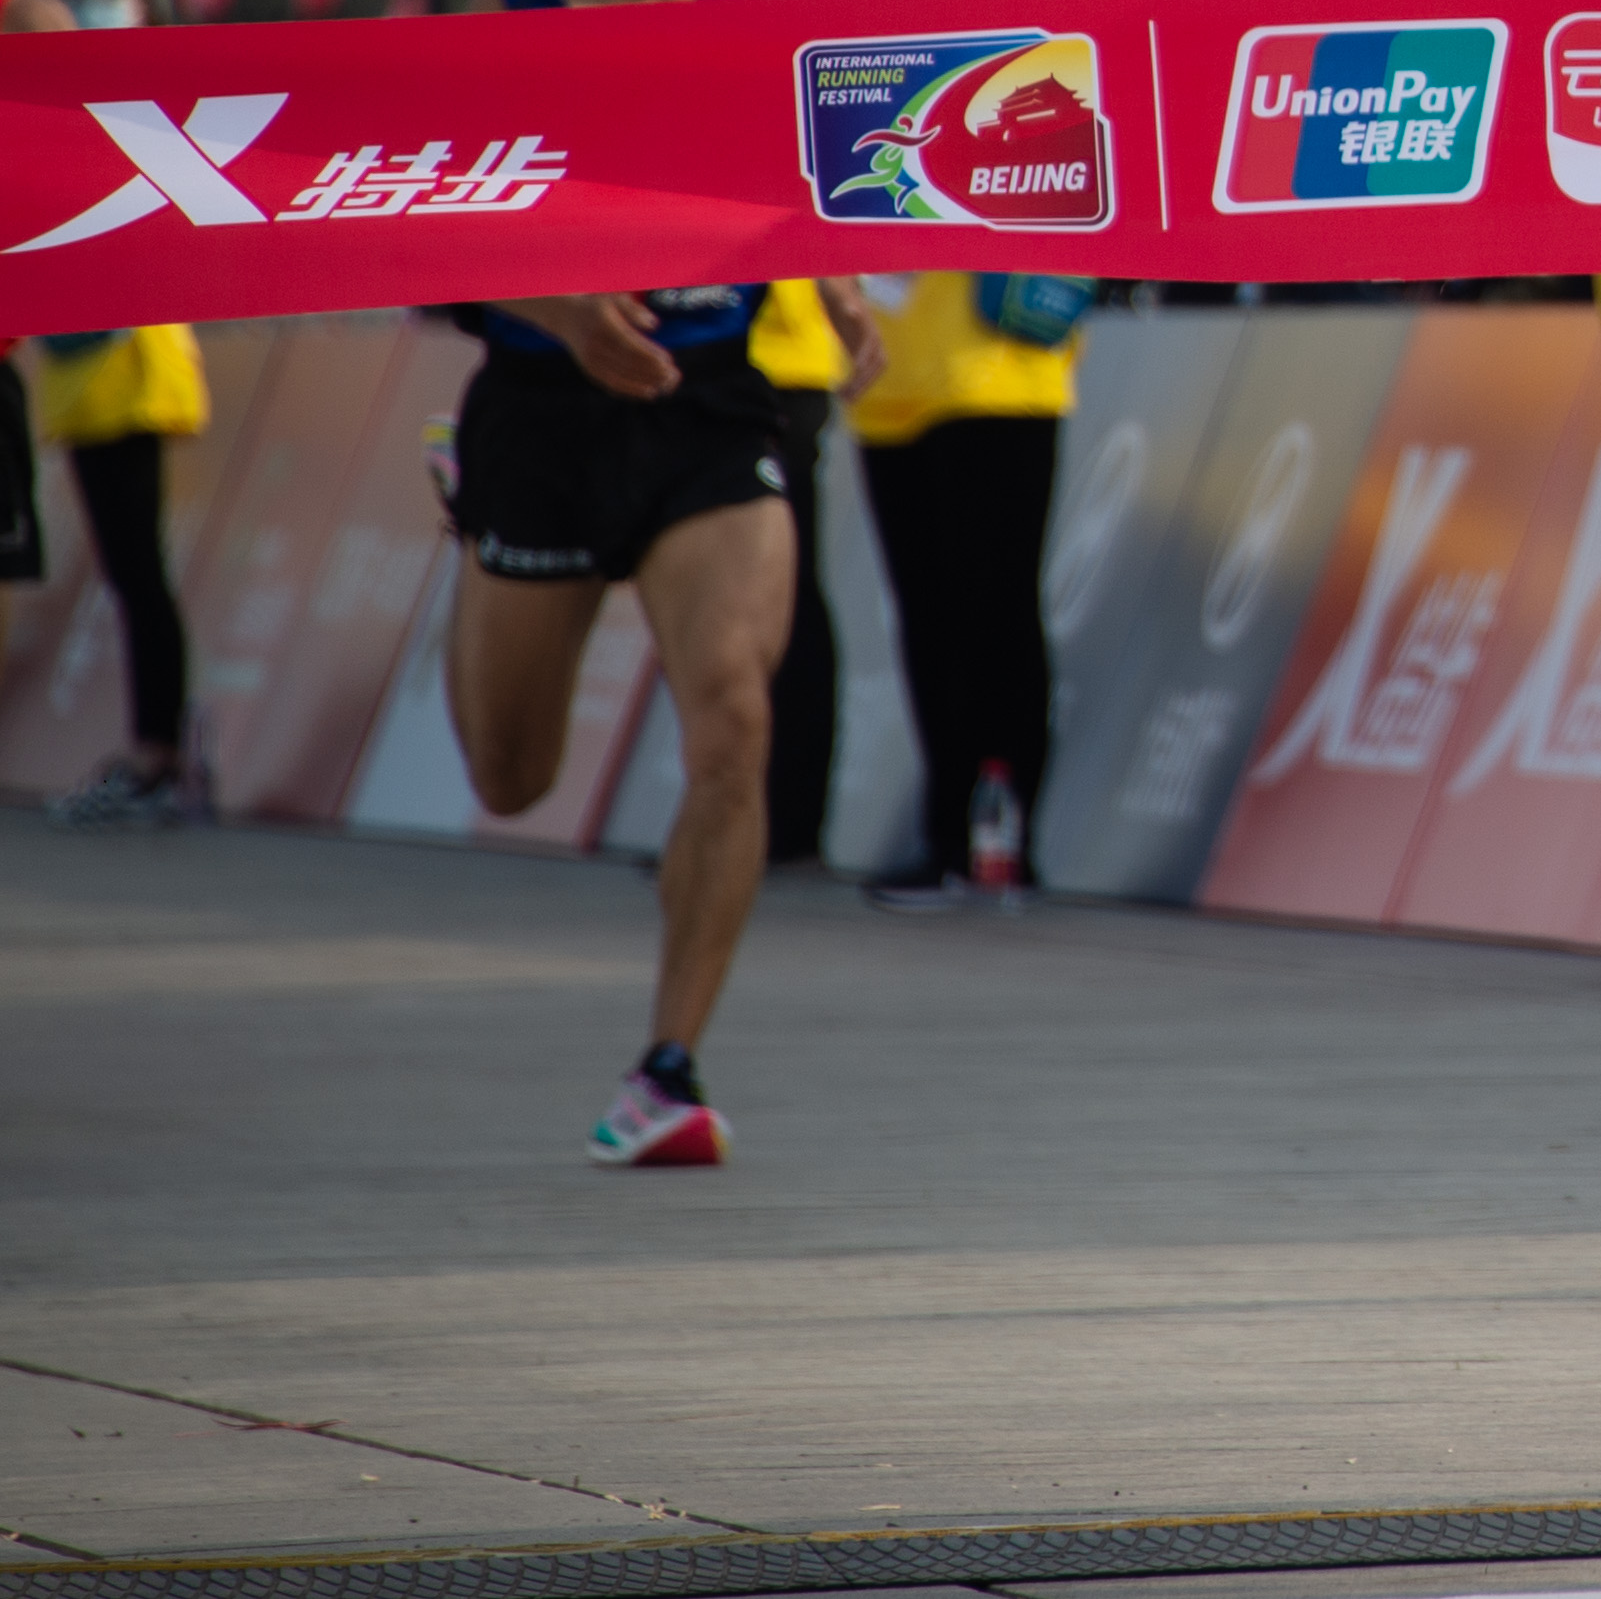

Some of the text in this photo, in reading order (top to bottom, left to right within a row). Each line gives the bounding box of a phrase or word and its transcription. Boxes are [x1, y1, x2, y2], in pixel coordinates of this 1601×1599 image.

[815, 51, 937, 70] INTERNATIONAL
[816, 67, 906, 89] RUNNING
[817, 87, 893, 107] FESTIVAL
[1250, 69, 1478, 129] UnionPay
[1339, 118, 1457, 166] 银联
[272, 135, 569, 222] 特步
[968, 161, 1089, 196] BEIJING
